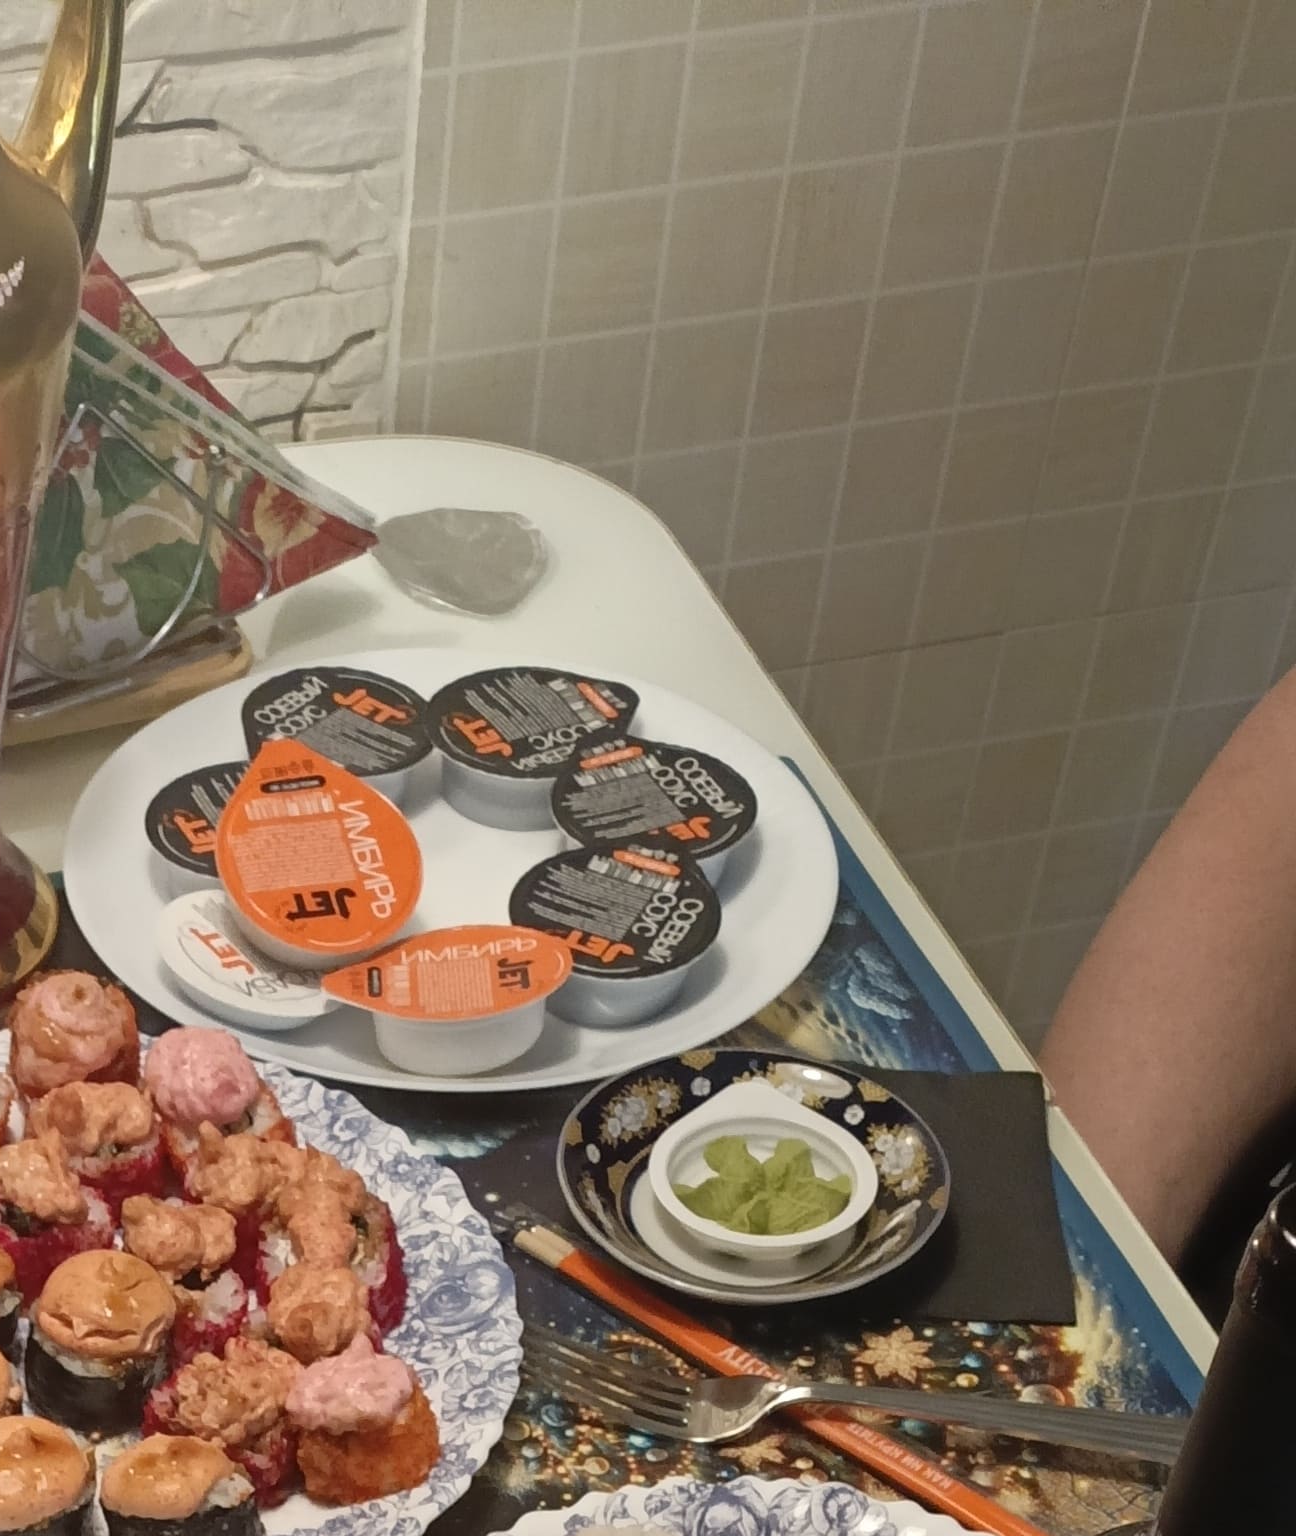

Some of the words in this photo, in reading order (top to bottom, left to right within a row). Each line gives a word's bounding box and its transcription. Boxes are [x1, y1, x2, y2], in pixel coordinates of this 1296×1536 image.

[254, 676, 329, 725] СОЕВЫЙ
[332, 688, 408, 724] JET
[274, 705, 327, 736] СОУС
[453, 716, 513, 758] JET
[651, 766, 699, 808] СОУС
[675, 757, 745, 820] СОЕВЫЙ
[648, 816, 712, 841] JE
[337, 799, 397, 919] ИМБИРЬ
[285, 887, 357, 922] JET
[631, 892, 678, 938] СОУС
[189, 927, 255, 975] JET
[400, 936, 538, 964] ИМБИРЬ
[565, 929, 636, 963] JET
[642, 898, 705, 965] СОЕВЫЙ
[497, 957, 535, 990] JET
[923, 1465, 954, 1489] КАК
